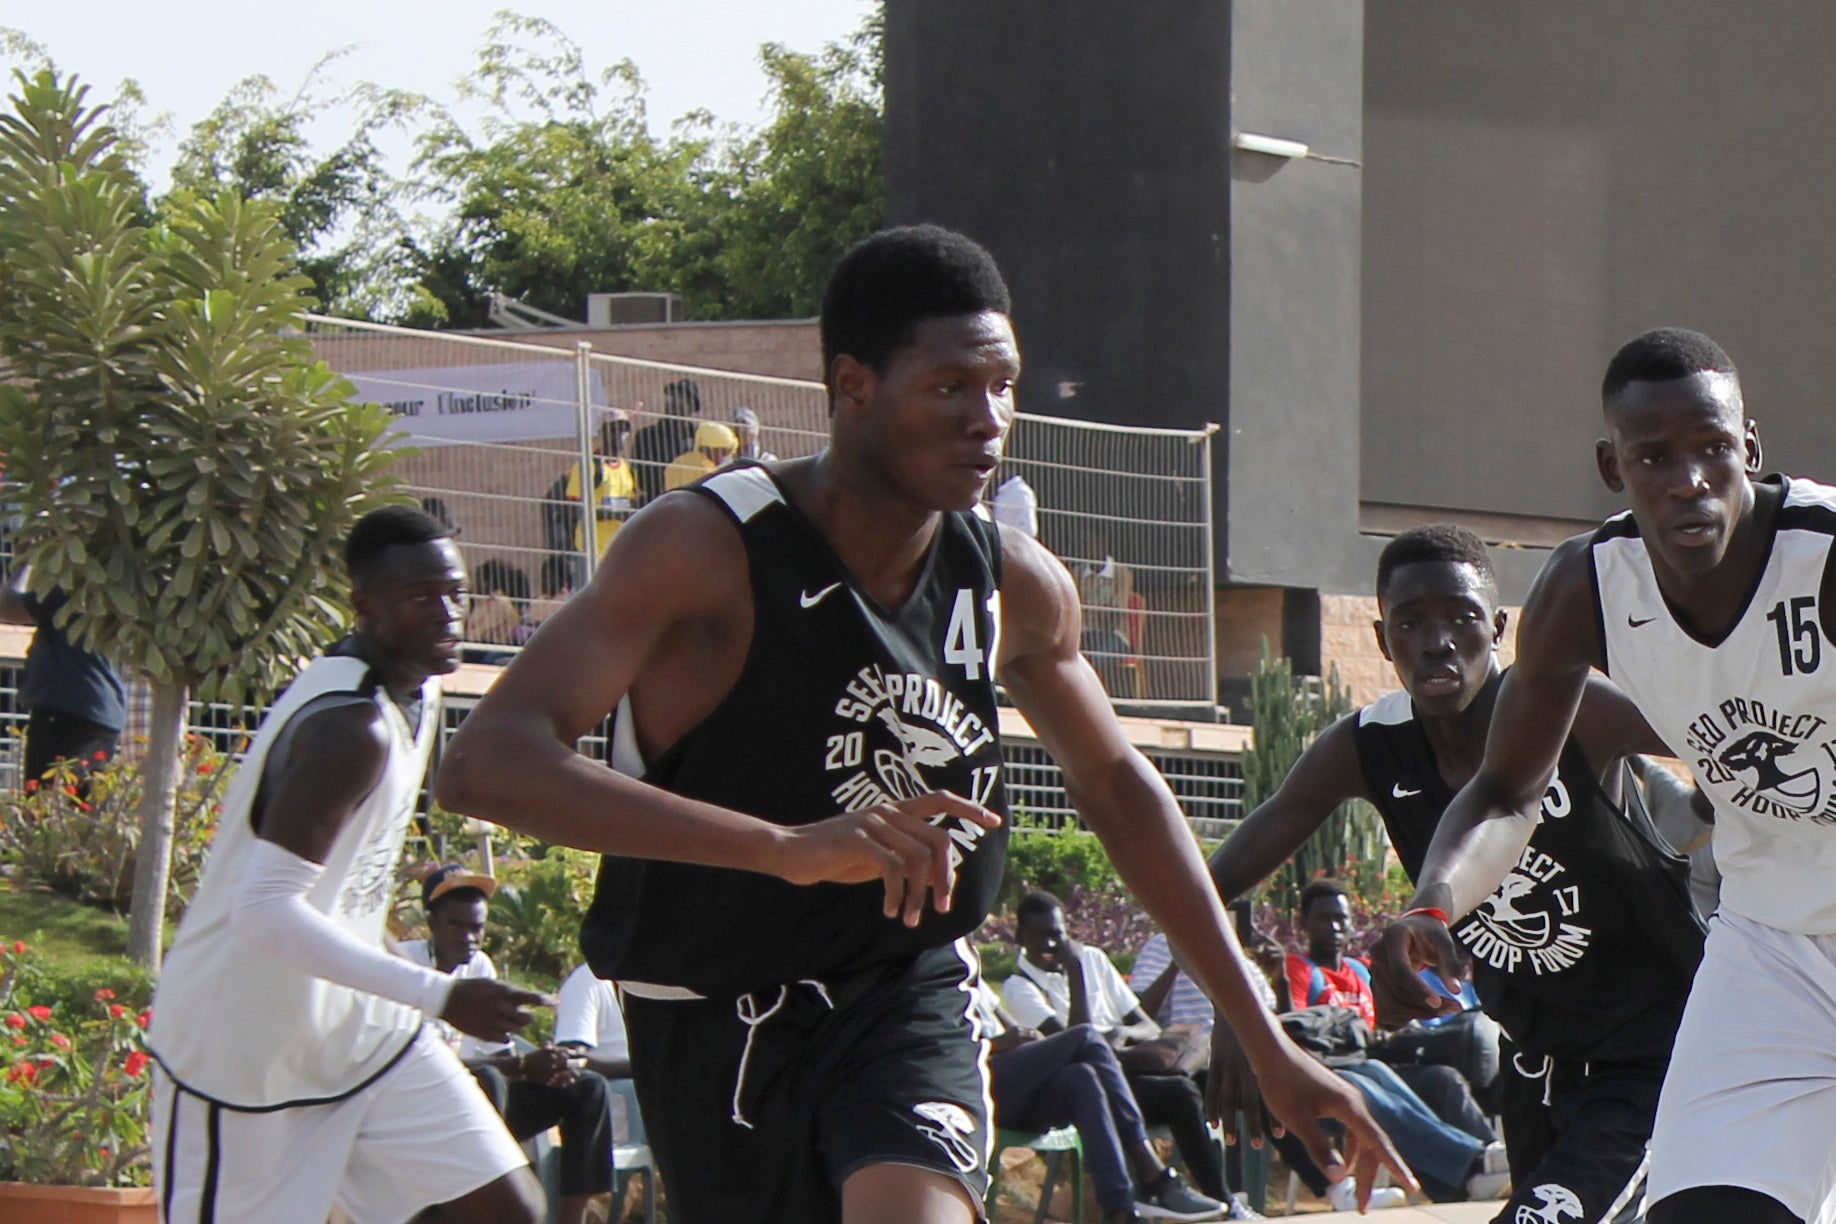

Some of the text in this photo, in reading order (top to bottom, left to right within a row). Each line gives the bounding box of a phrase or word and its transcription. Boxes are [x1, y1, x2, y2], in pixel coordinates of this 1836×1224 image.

[1766, 596, 1820, 676] 15
[834, 662, 995, 758] SEE PROJECT
[1719, 696, 1828, 740] PROJECT
[824, 731, 864, 771] 20
[1697, 757, 1737, 785] 20
[970, 765, 999, 806] 17
[1552, 885, 1580, 917] 17
[1456, 920, 1592, 976] HOOP FORUM
